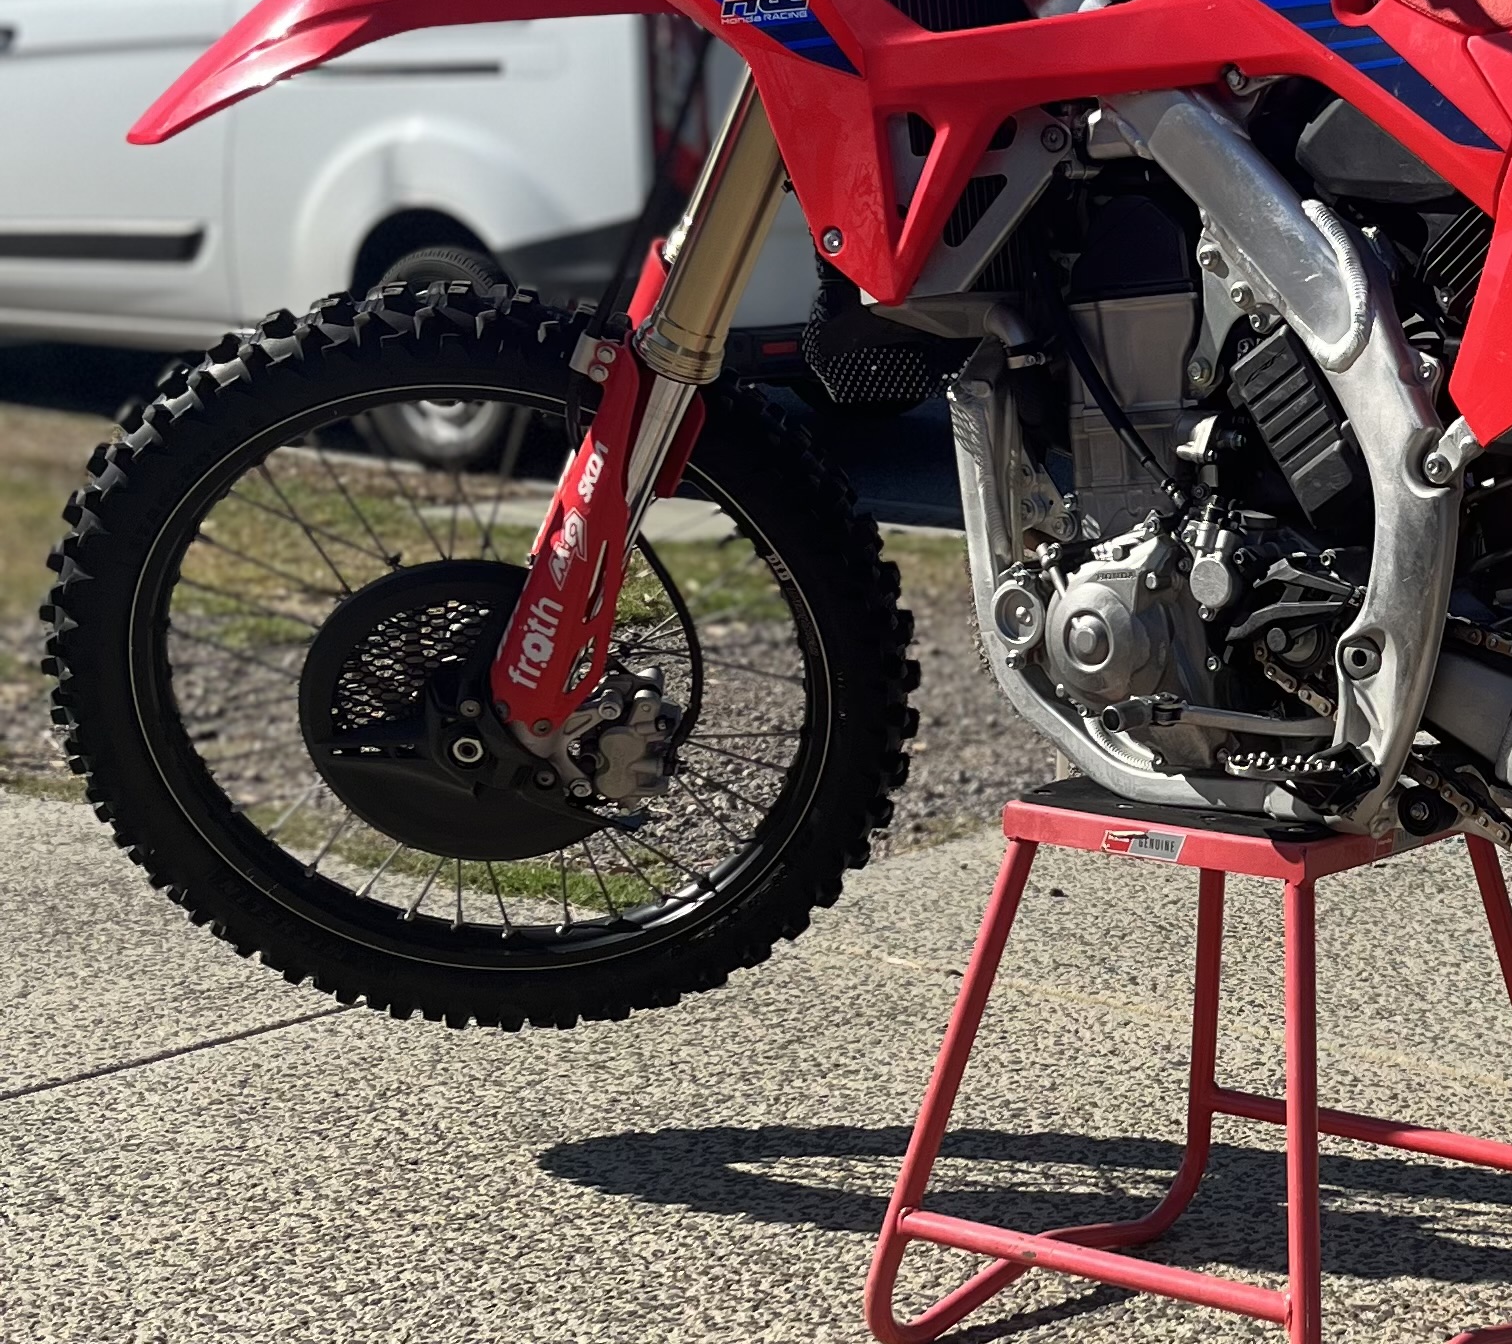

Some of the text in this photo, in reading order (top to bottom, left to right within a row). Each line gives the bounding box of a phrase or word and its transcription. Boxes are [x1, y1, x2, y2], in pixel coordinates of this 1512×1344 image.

[721, 10, 808, 25] Honda RACING
[1097, 570, 1135, 580] HONDA
[508, 597, 564, 690] froth
[1138, 837, 1176, 853] GENUINE
